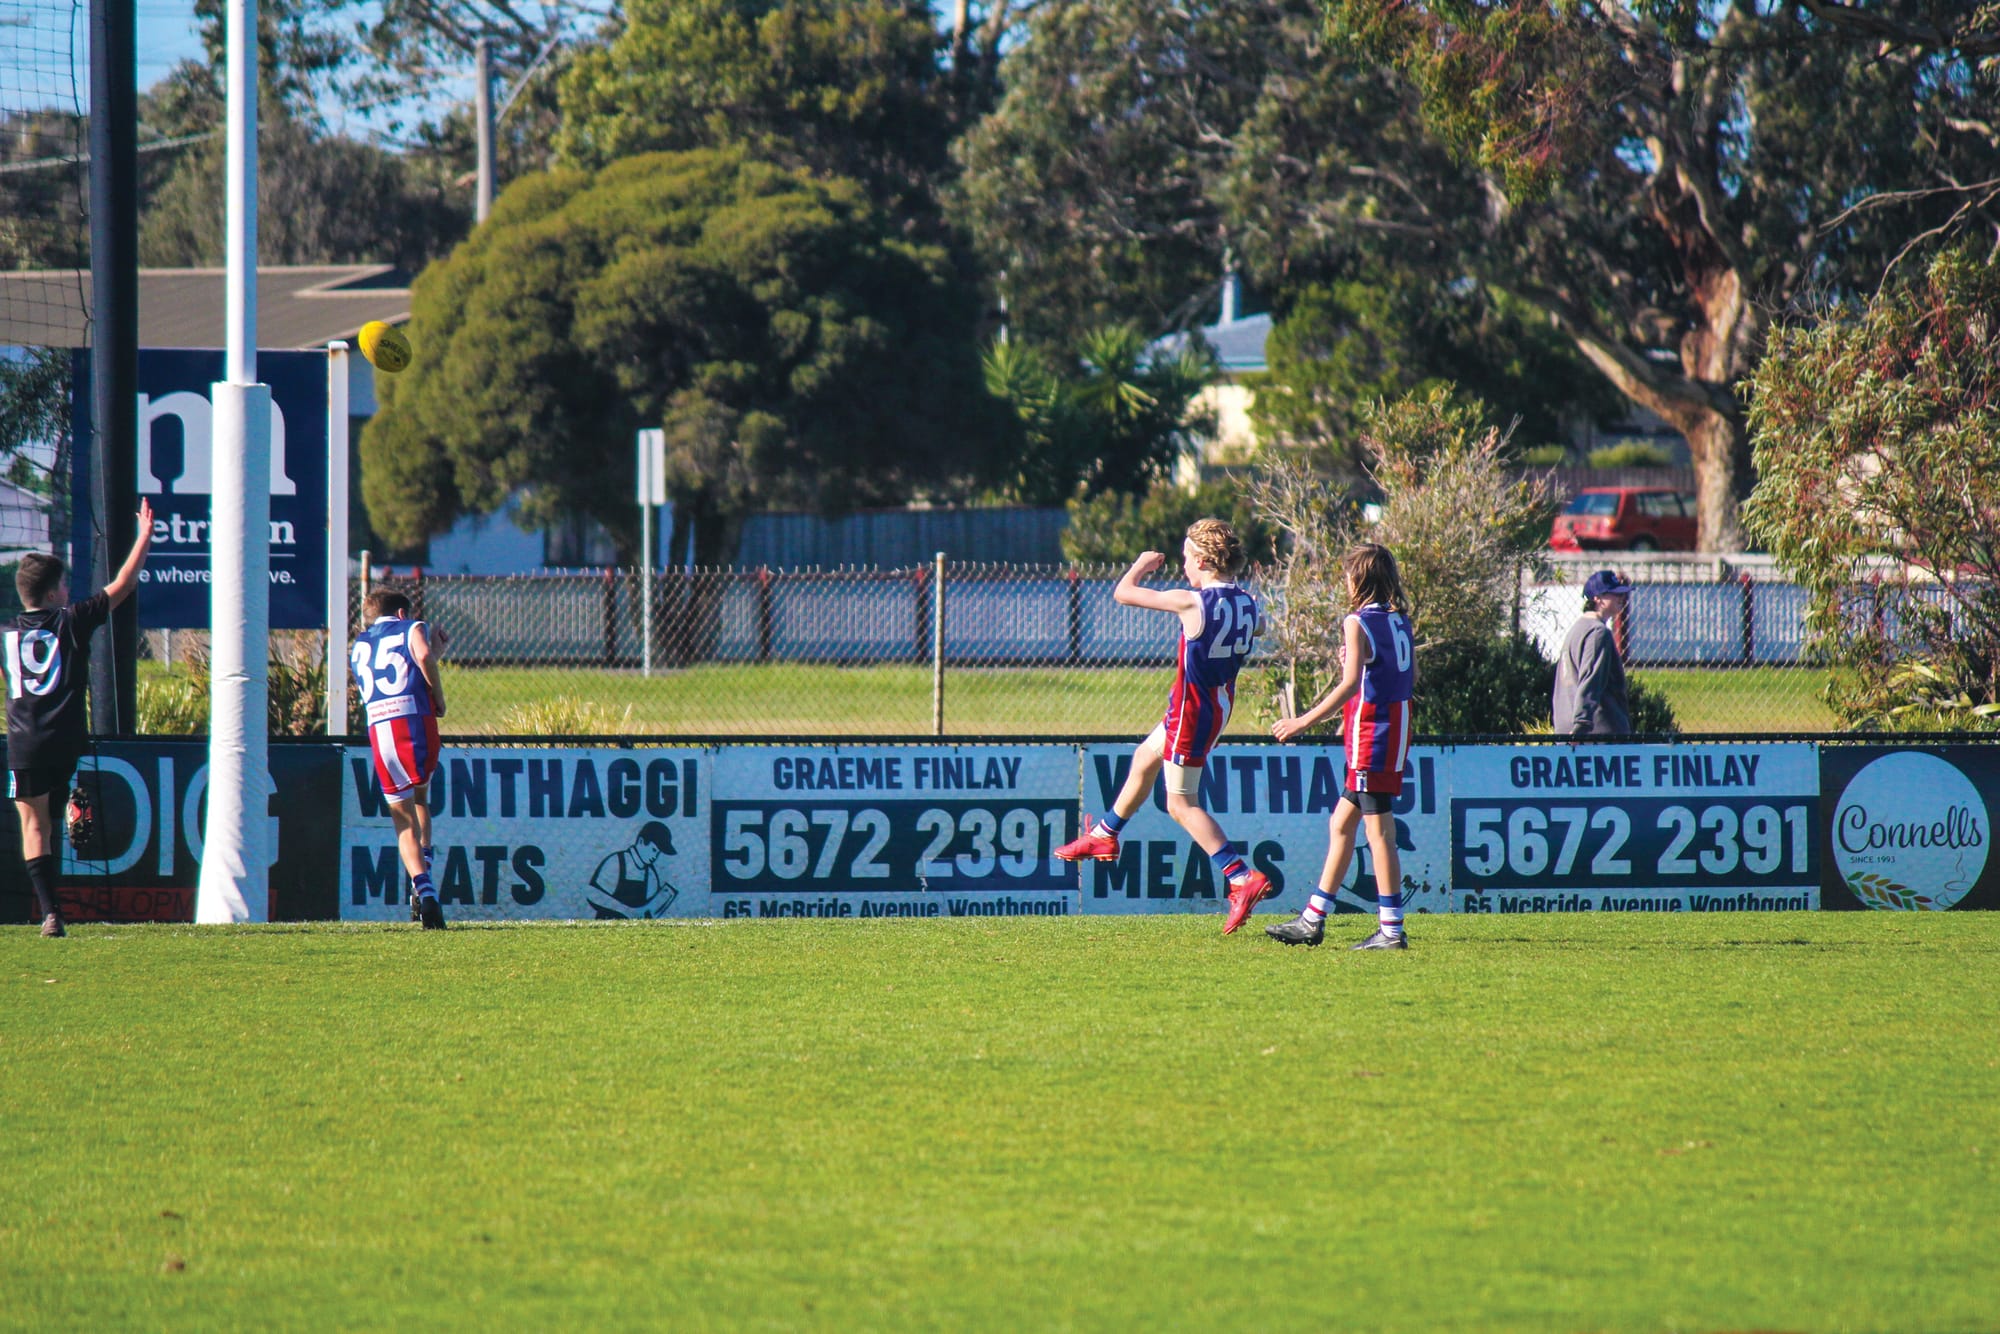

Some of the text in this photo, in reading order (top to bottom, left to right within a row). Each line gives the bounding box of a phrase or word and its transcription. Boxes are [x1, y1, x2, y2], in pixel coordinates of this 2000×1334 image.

[1207, 595, 1254, 658] 25
[1388, 613, 1411, 672] 6
[3, 629, 62, 699] 19
[351, 632, 408, 704] 35
[773, 757, 1022, 790] GRAEME FINLAY
[1510, 755, 1760, 788] GRAEME FINLAY
[723, 808, 1066, 879] 5672 2391
[1464, 805, 1808, 876] 5672 2391
[1838, 804, 1983, 853] Connells
[351, 845, 545, 905] MATS
[1850, 856, 1896, 864] SINCE 1993
[723, 901, 751, 918] 65
